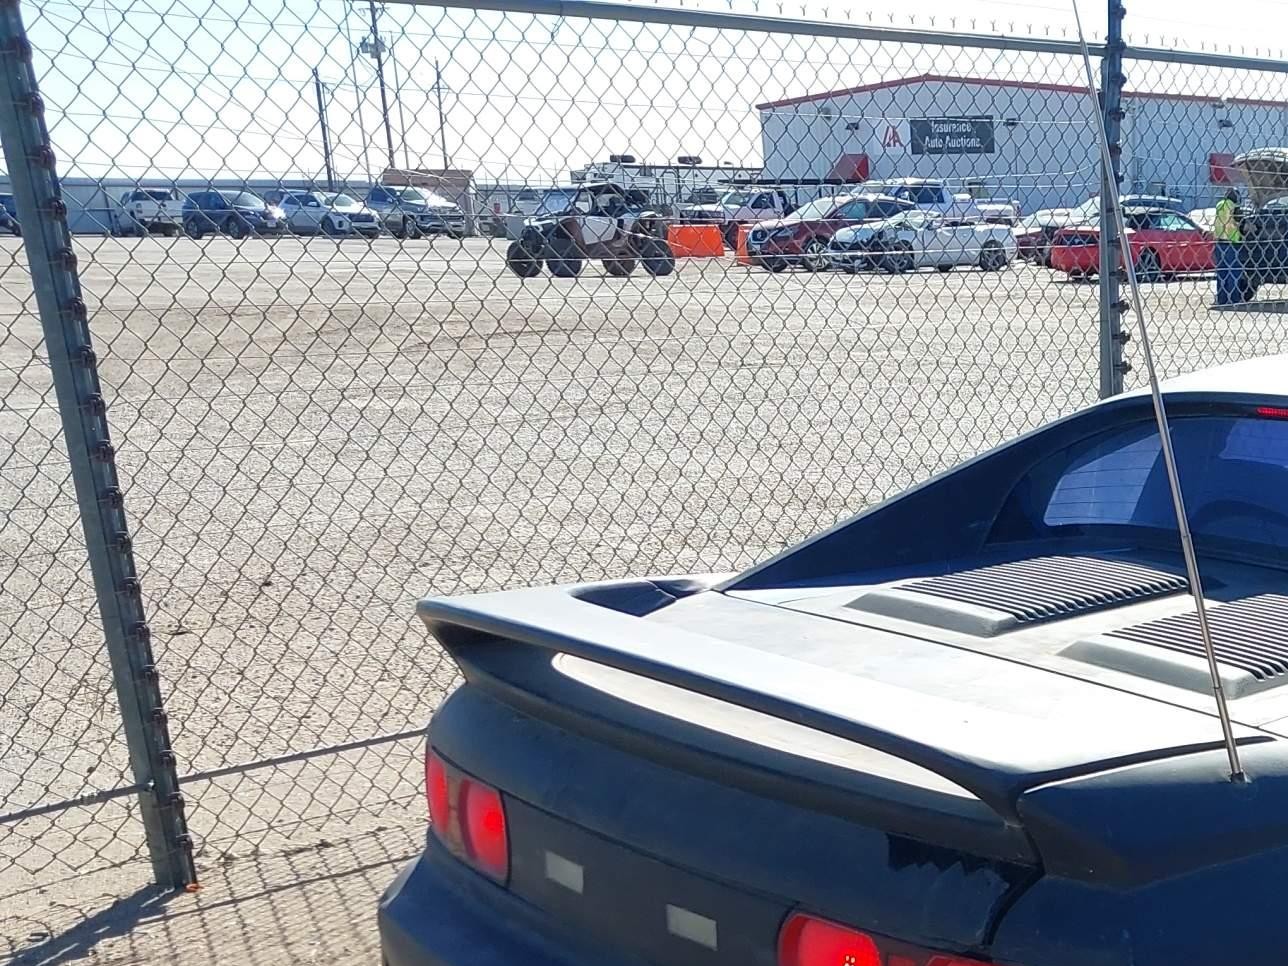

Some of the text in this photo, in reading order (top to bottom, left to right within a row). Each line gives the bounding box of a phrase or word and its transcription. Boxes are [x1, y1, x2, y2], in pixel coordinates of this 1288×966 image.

[931, 121, 972, 133] Insurance
[925, 135, 981, 148] Auto Auctions
